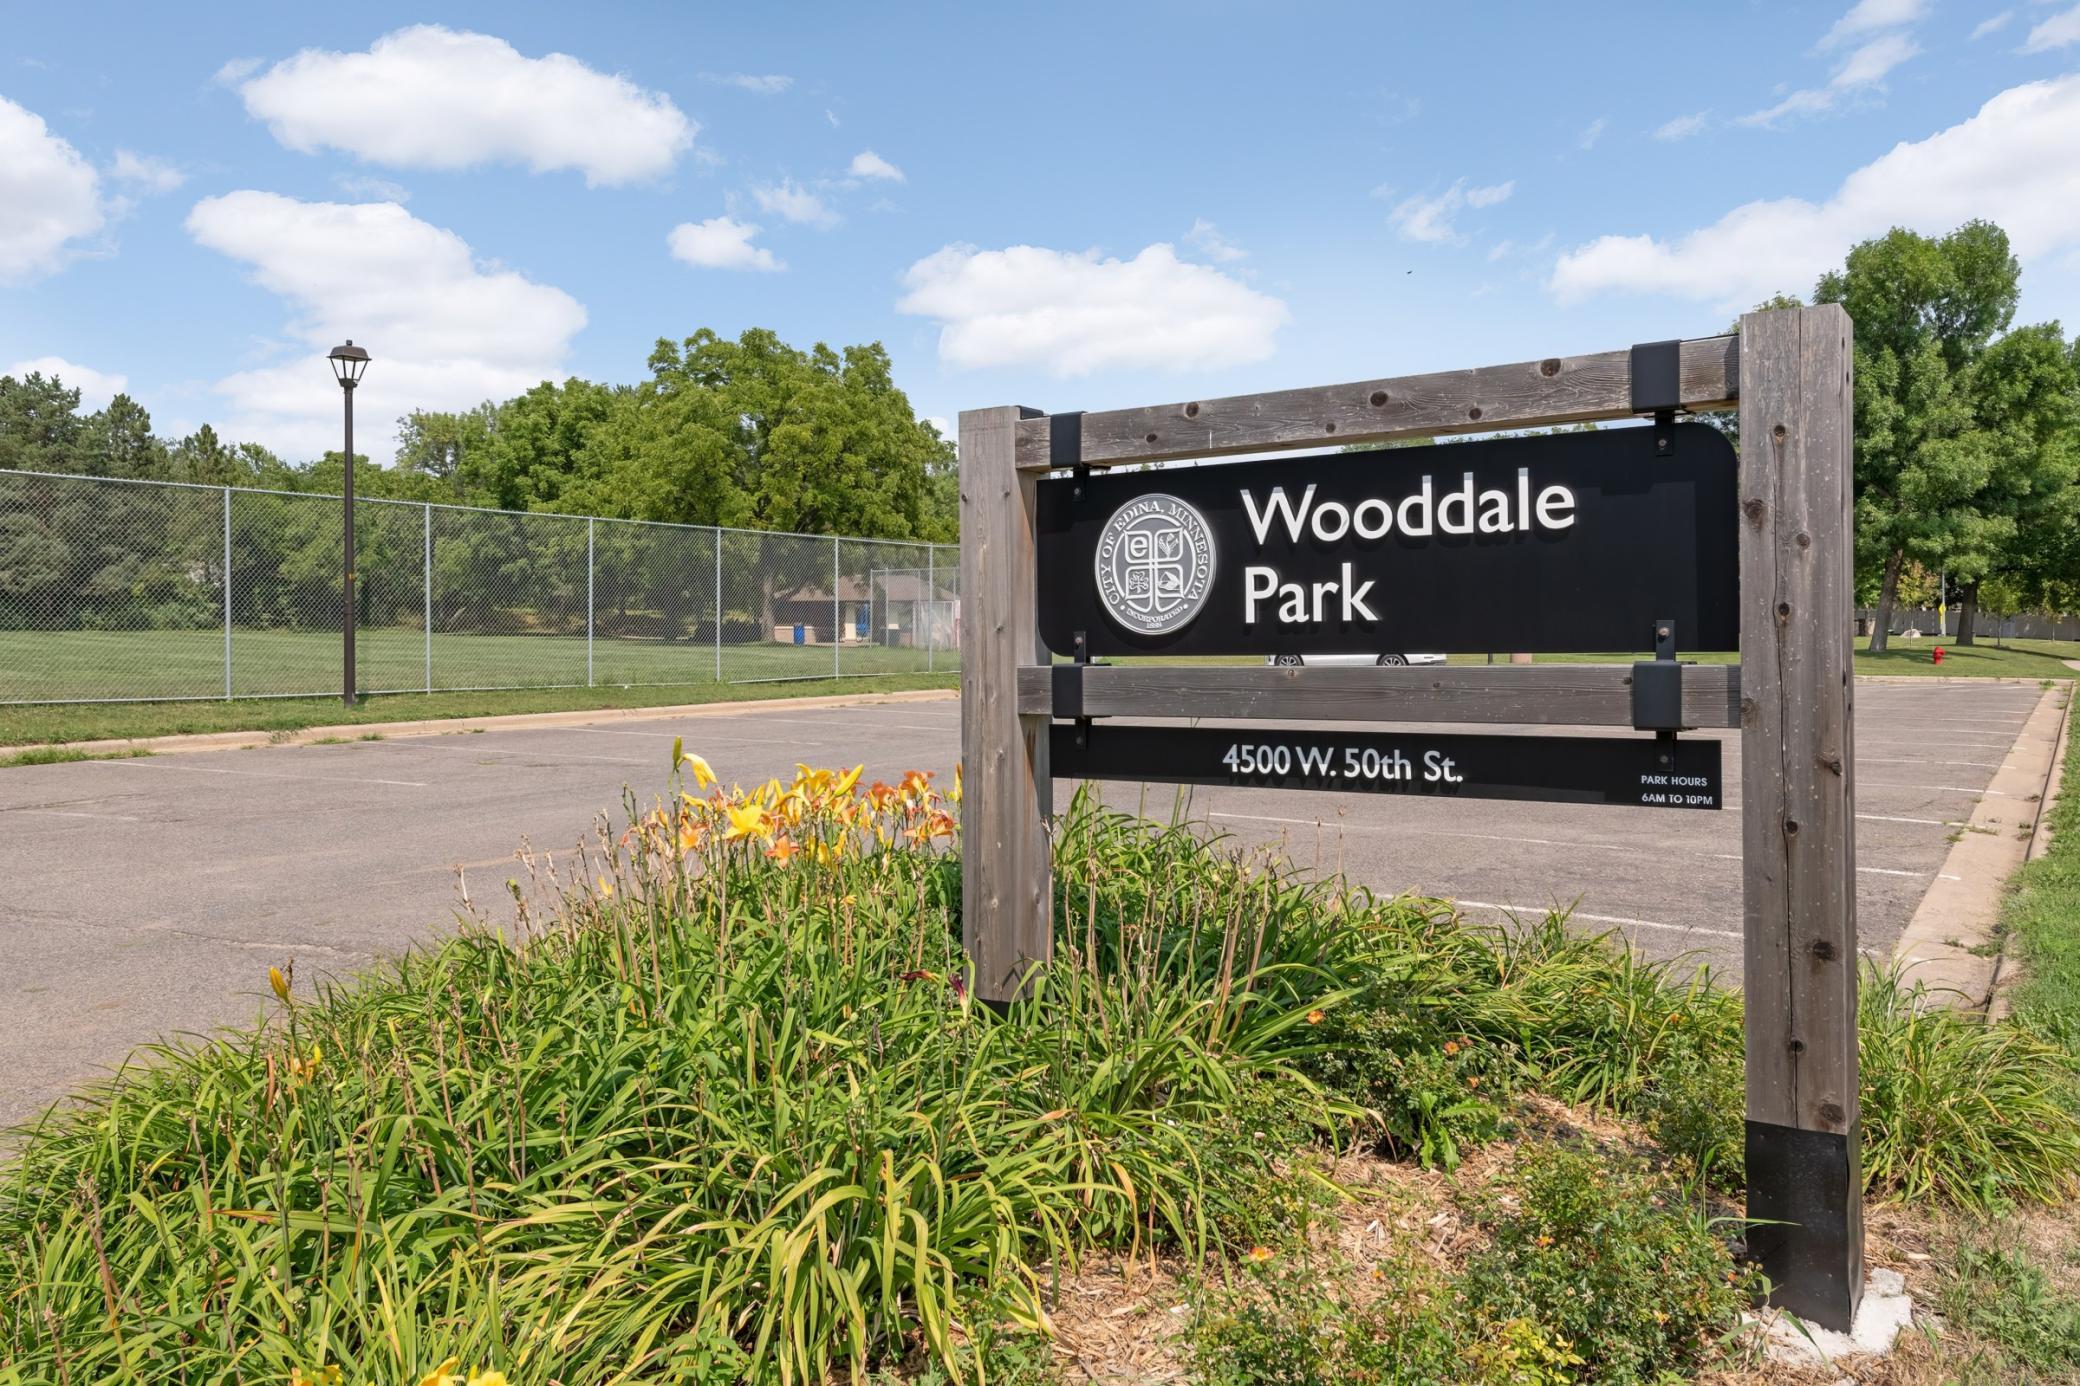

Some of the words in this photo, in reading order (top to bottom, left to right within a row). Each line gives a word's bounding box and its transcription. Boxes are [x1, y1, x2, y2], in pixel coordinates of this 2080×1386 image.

[1240, 467, 1576, 546] Wooddale
[1102, 533, 1115, 558] OF
[1168, 503, 1209, 601] MINNESOTA
[1101, 564, 1120, 605] CITY
[1244, 562, 1379, 624] Park
[1222, 743, 1291, 775] 4500
[1295, 746, 1336, 777] W.
[1344, 748, 1412, 780] 50th
[1423, 750, 1463, 783] St.
[1641, 775, 1668, 785] PARK
[1671, 776, 1708, 787] HOURS
[1642, 793, 1665, 803] 6AM
[1669, 794, 1683, 804] TO
[1686, 795, 1713, 805] 10PM
